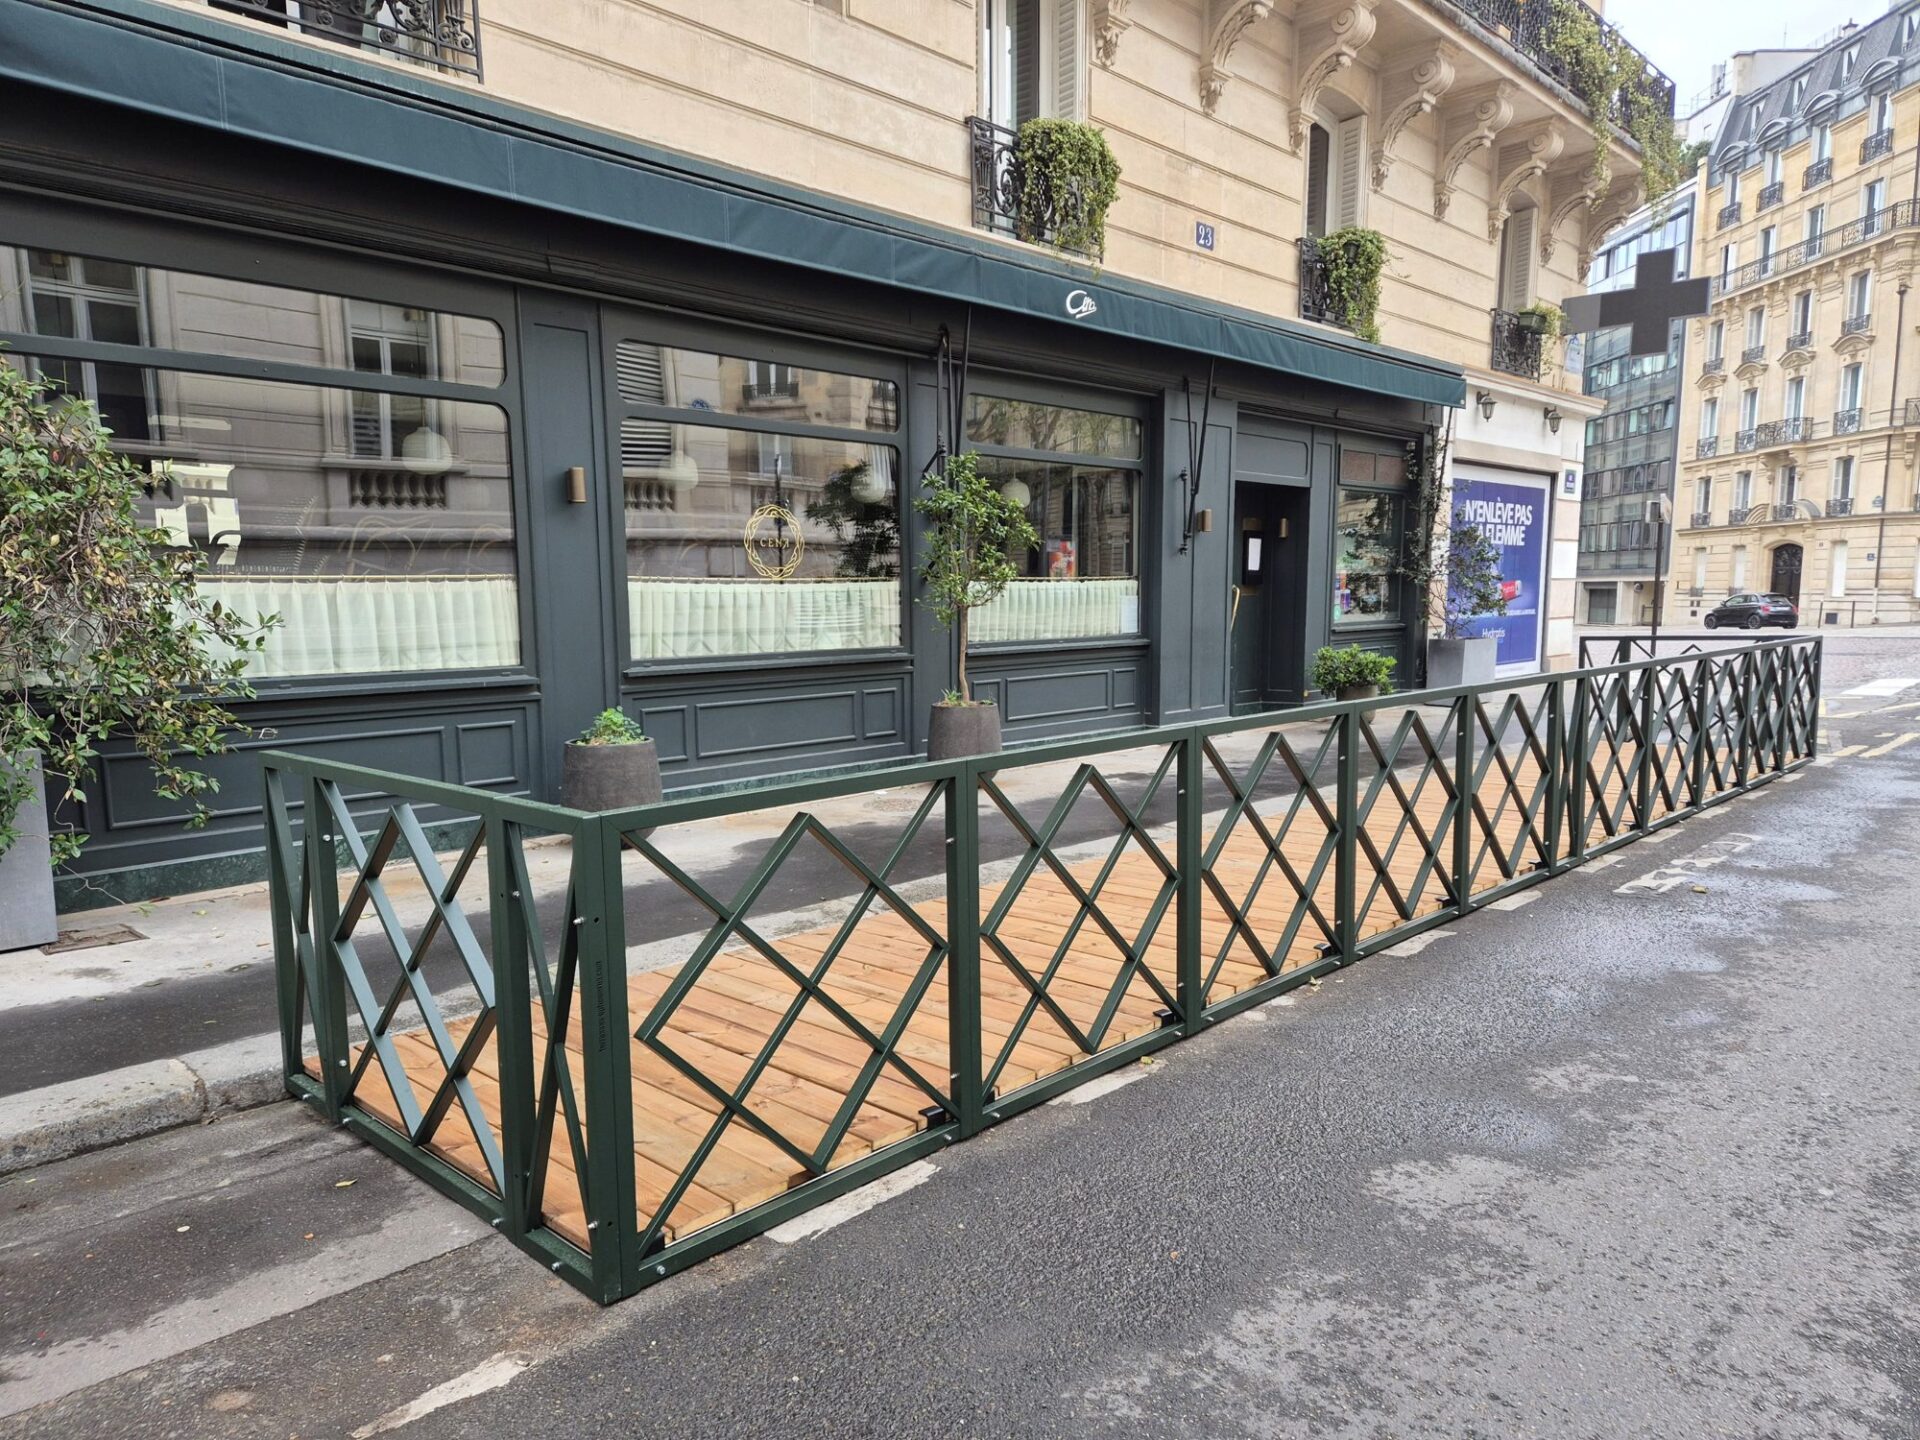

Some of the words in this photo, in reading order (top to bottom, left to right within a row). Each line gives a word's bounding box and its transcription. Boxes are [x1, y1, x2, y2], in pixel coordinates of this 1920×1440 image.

[1198, 225, 1212, 247] 23
[1465, 496, 1515, 524] N'ENLÈVE
[1515, 504, 1532, 525] PAS
[1486, 524, 1526, 546] FLEMME
